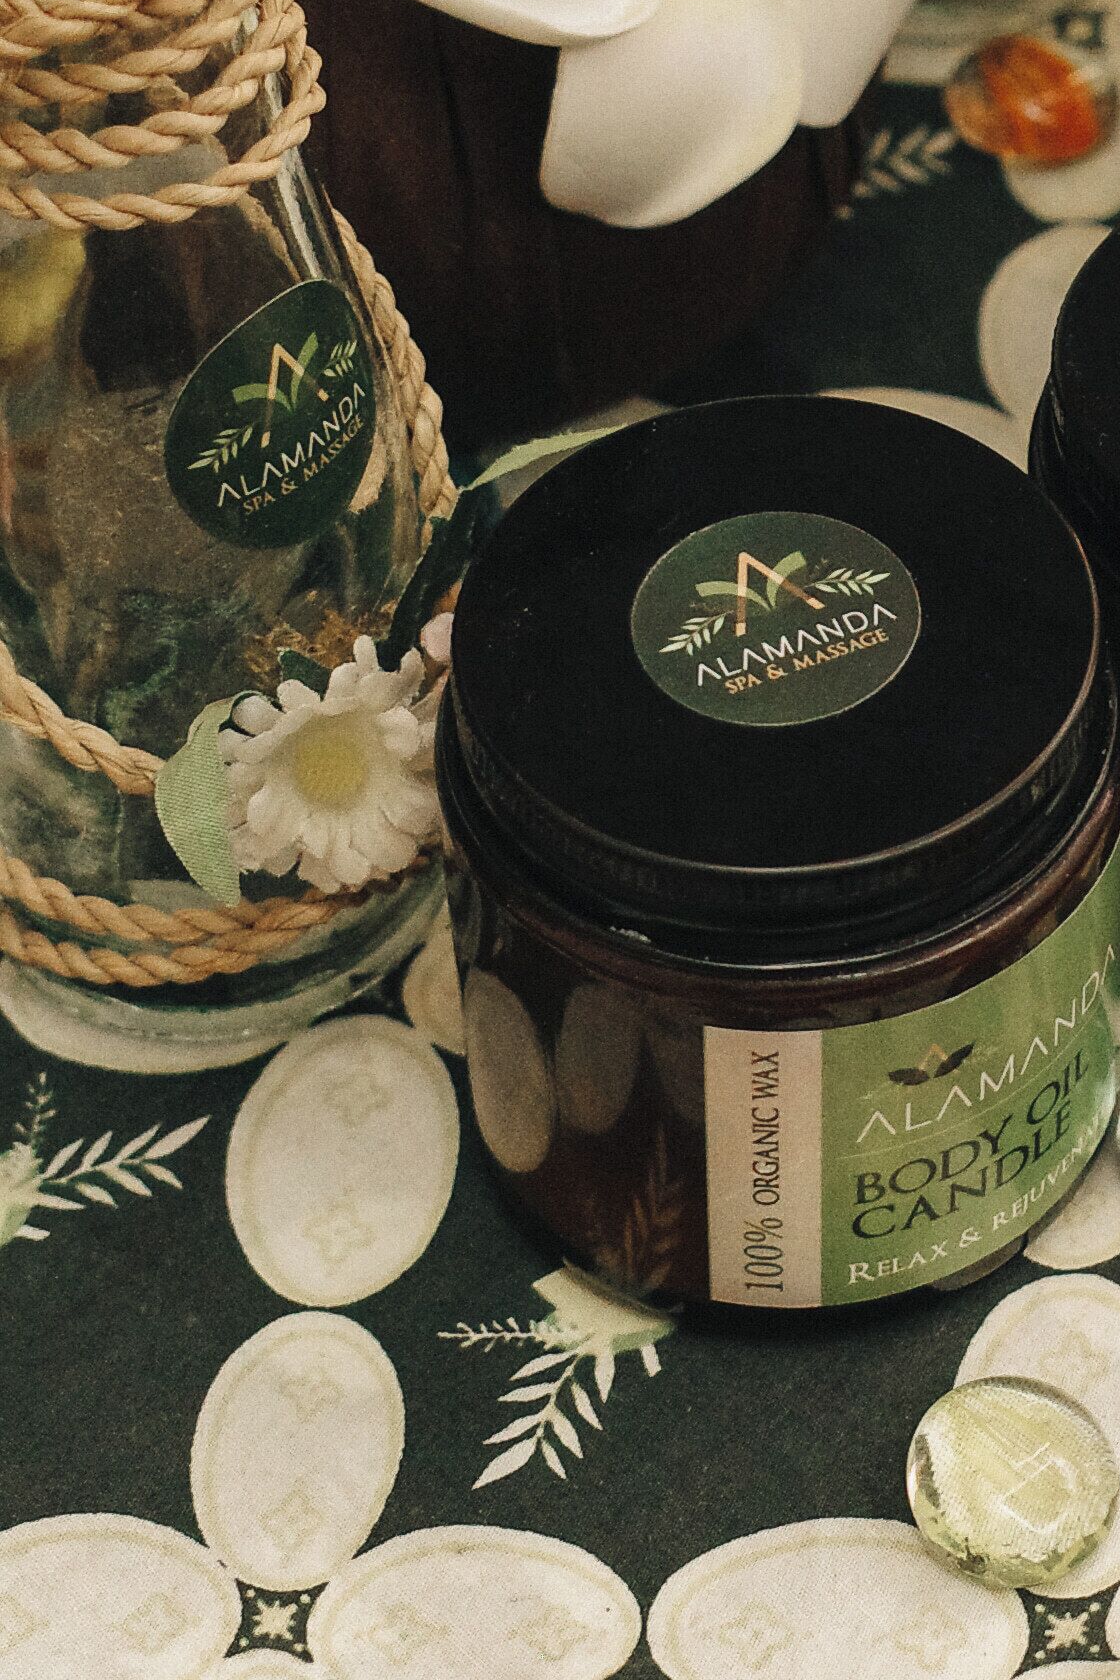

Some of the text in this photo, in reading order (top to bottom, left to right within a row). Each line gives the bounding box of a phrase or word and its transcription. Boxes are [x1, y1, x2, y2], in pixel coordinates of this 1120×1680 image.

[217, 382, 366, 507] ALAMANDA
[243, 414, 364, 515] SPA & MASSAGE
[697, 603, 897, 686] ALAMANDA
[724, 629, 890, 695] SPA & MASSAGE
[856, 944, 1115, 1143] ALAMANDA
[743, 1051, 783, 1292] 100% ORGANIC WAX
[851, 1100, 1071, 1240] CANDLE
[854, 1049, 1090, 1206] BODY OIL
[847, 1239, 948, 1286] RELAX
[958, 1225, 982, 1248] &
